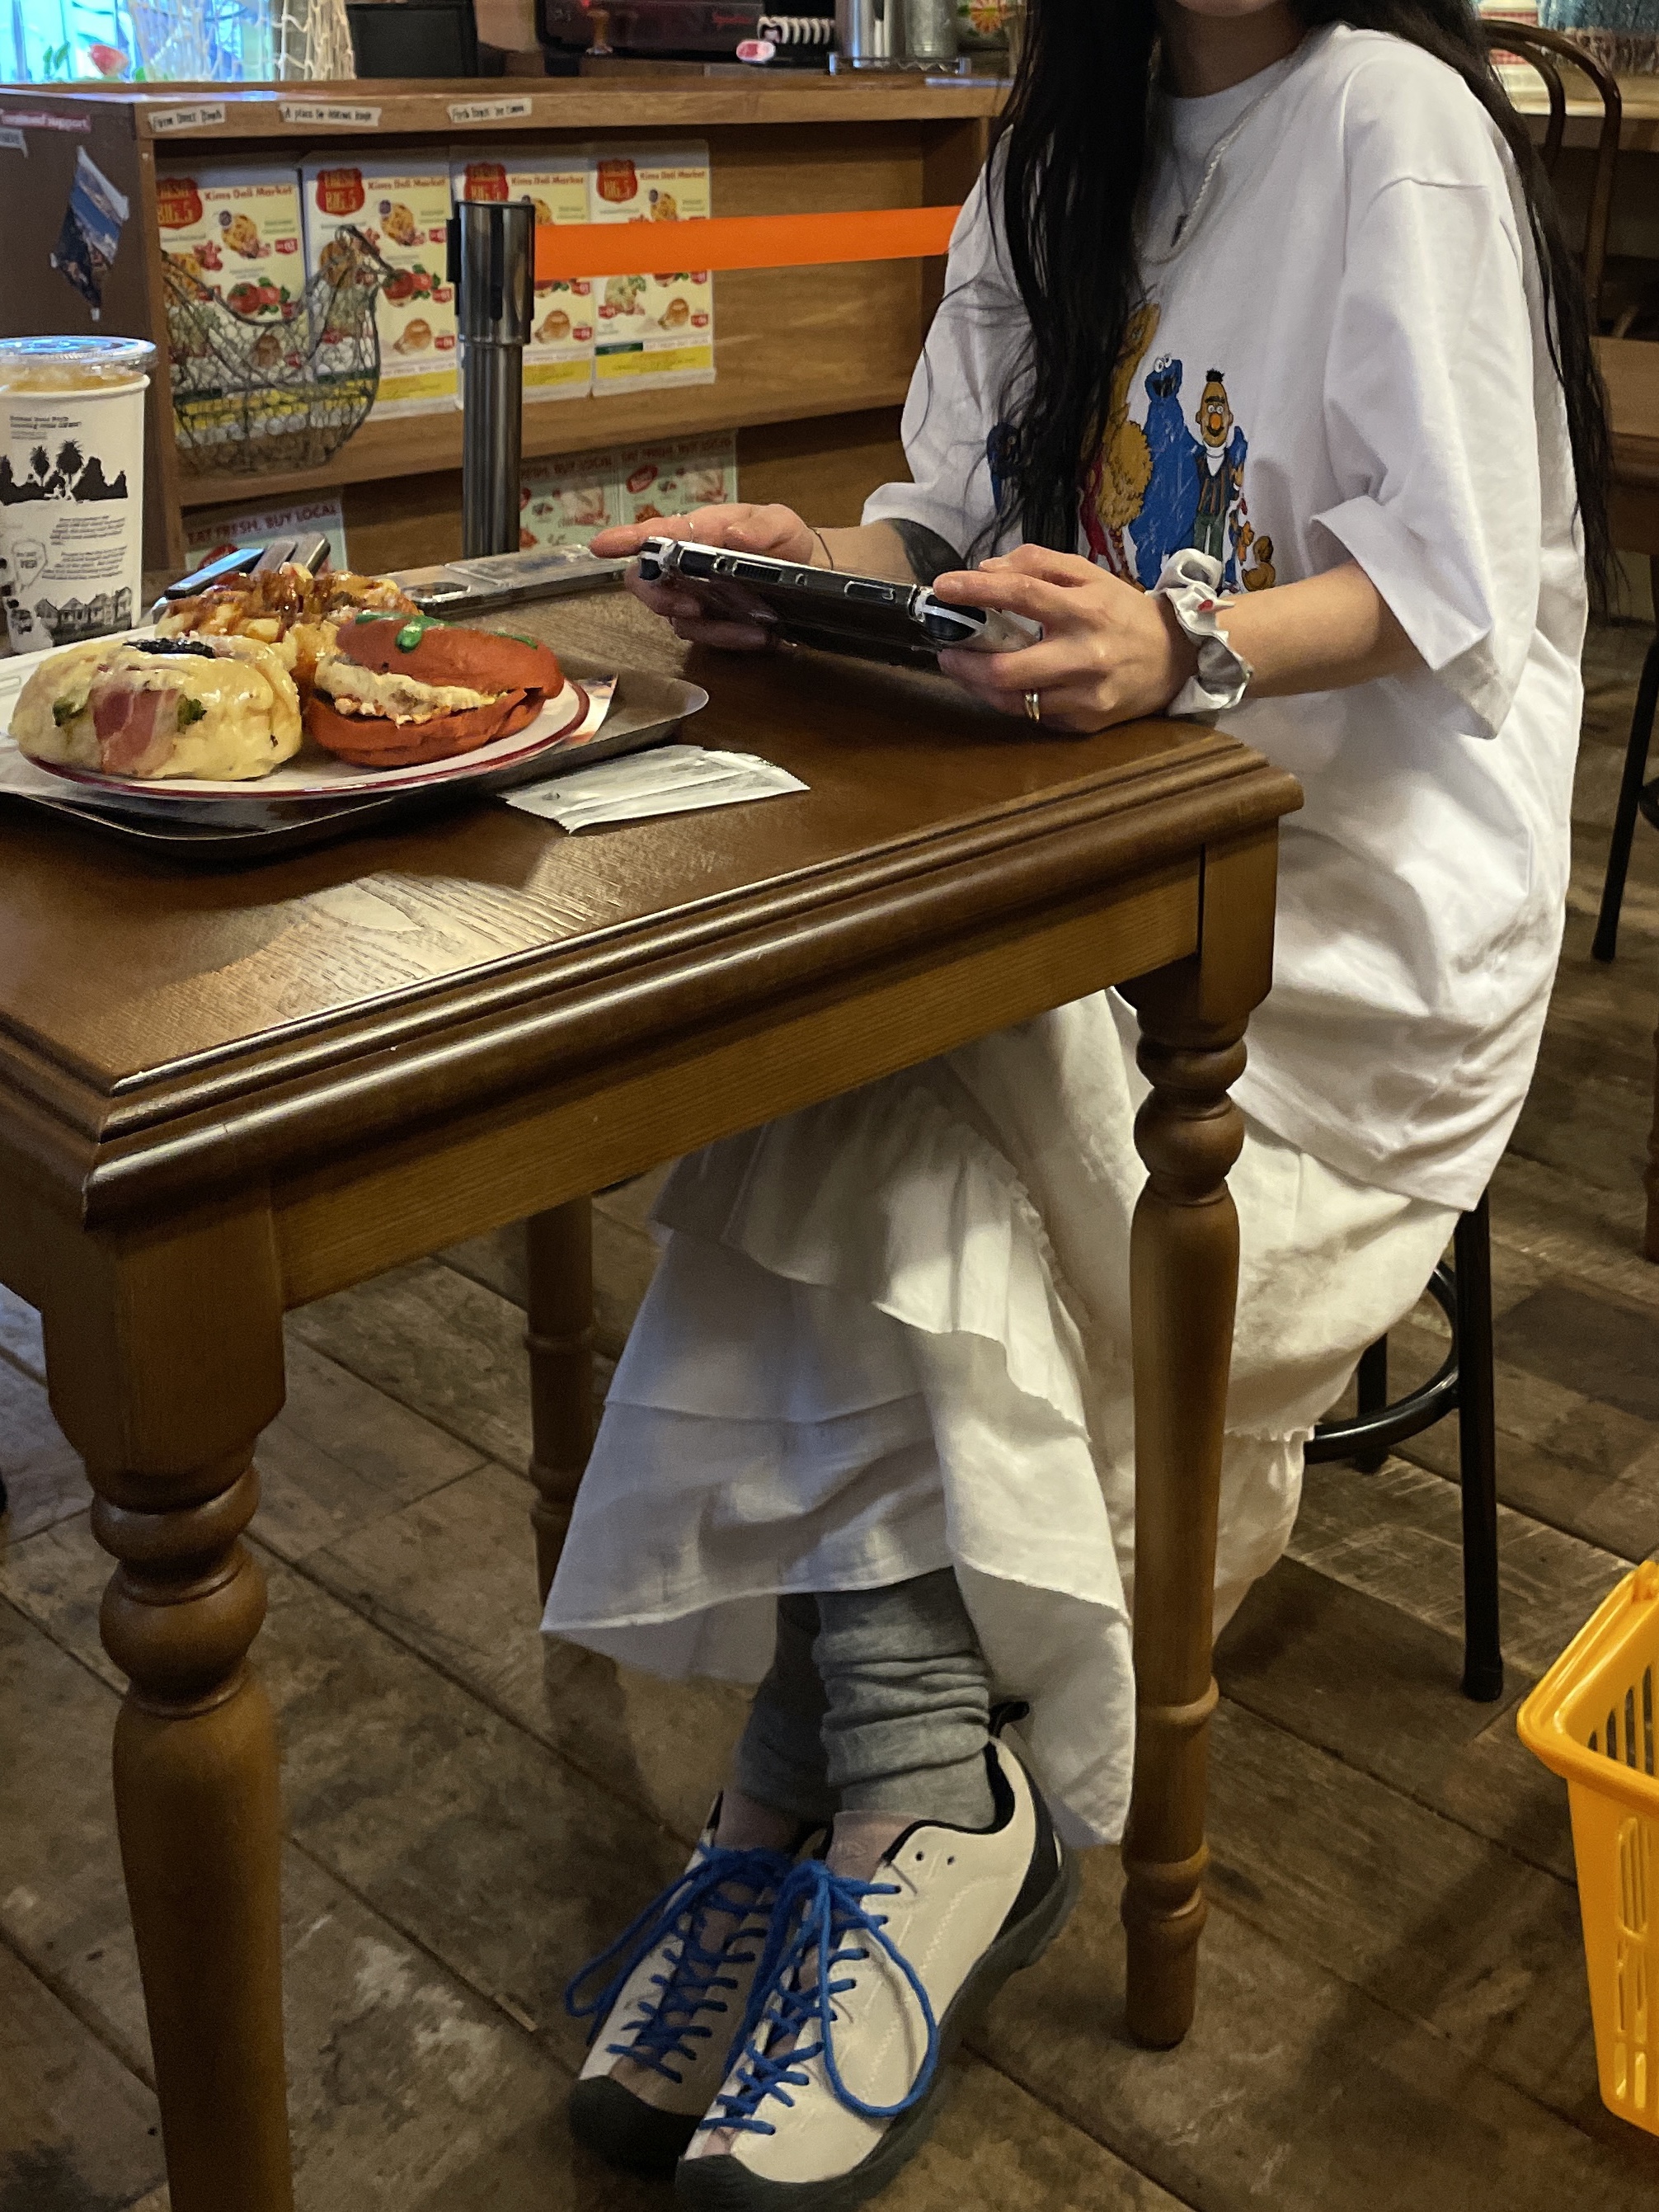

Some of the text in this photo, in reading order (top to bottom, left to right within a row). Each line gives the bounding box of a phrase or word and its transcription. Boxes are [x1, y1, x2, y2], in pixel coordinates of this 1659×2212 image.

[368, 180, 392, 191] Kims
[413, 176, 446, 188] Market
[205, 186, 293, 202] Kims Deli Market
[187, 528, 213, 545] EAT
[265, 513, 292, 529] BUY
[295, 504, 336, 522] LOCAL
